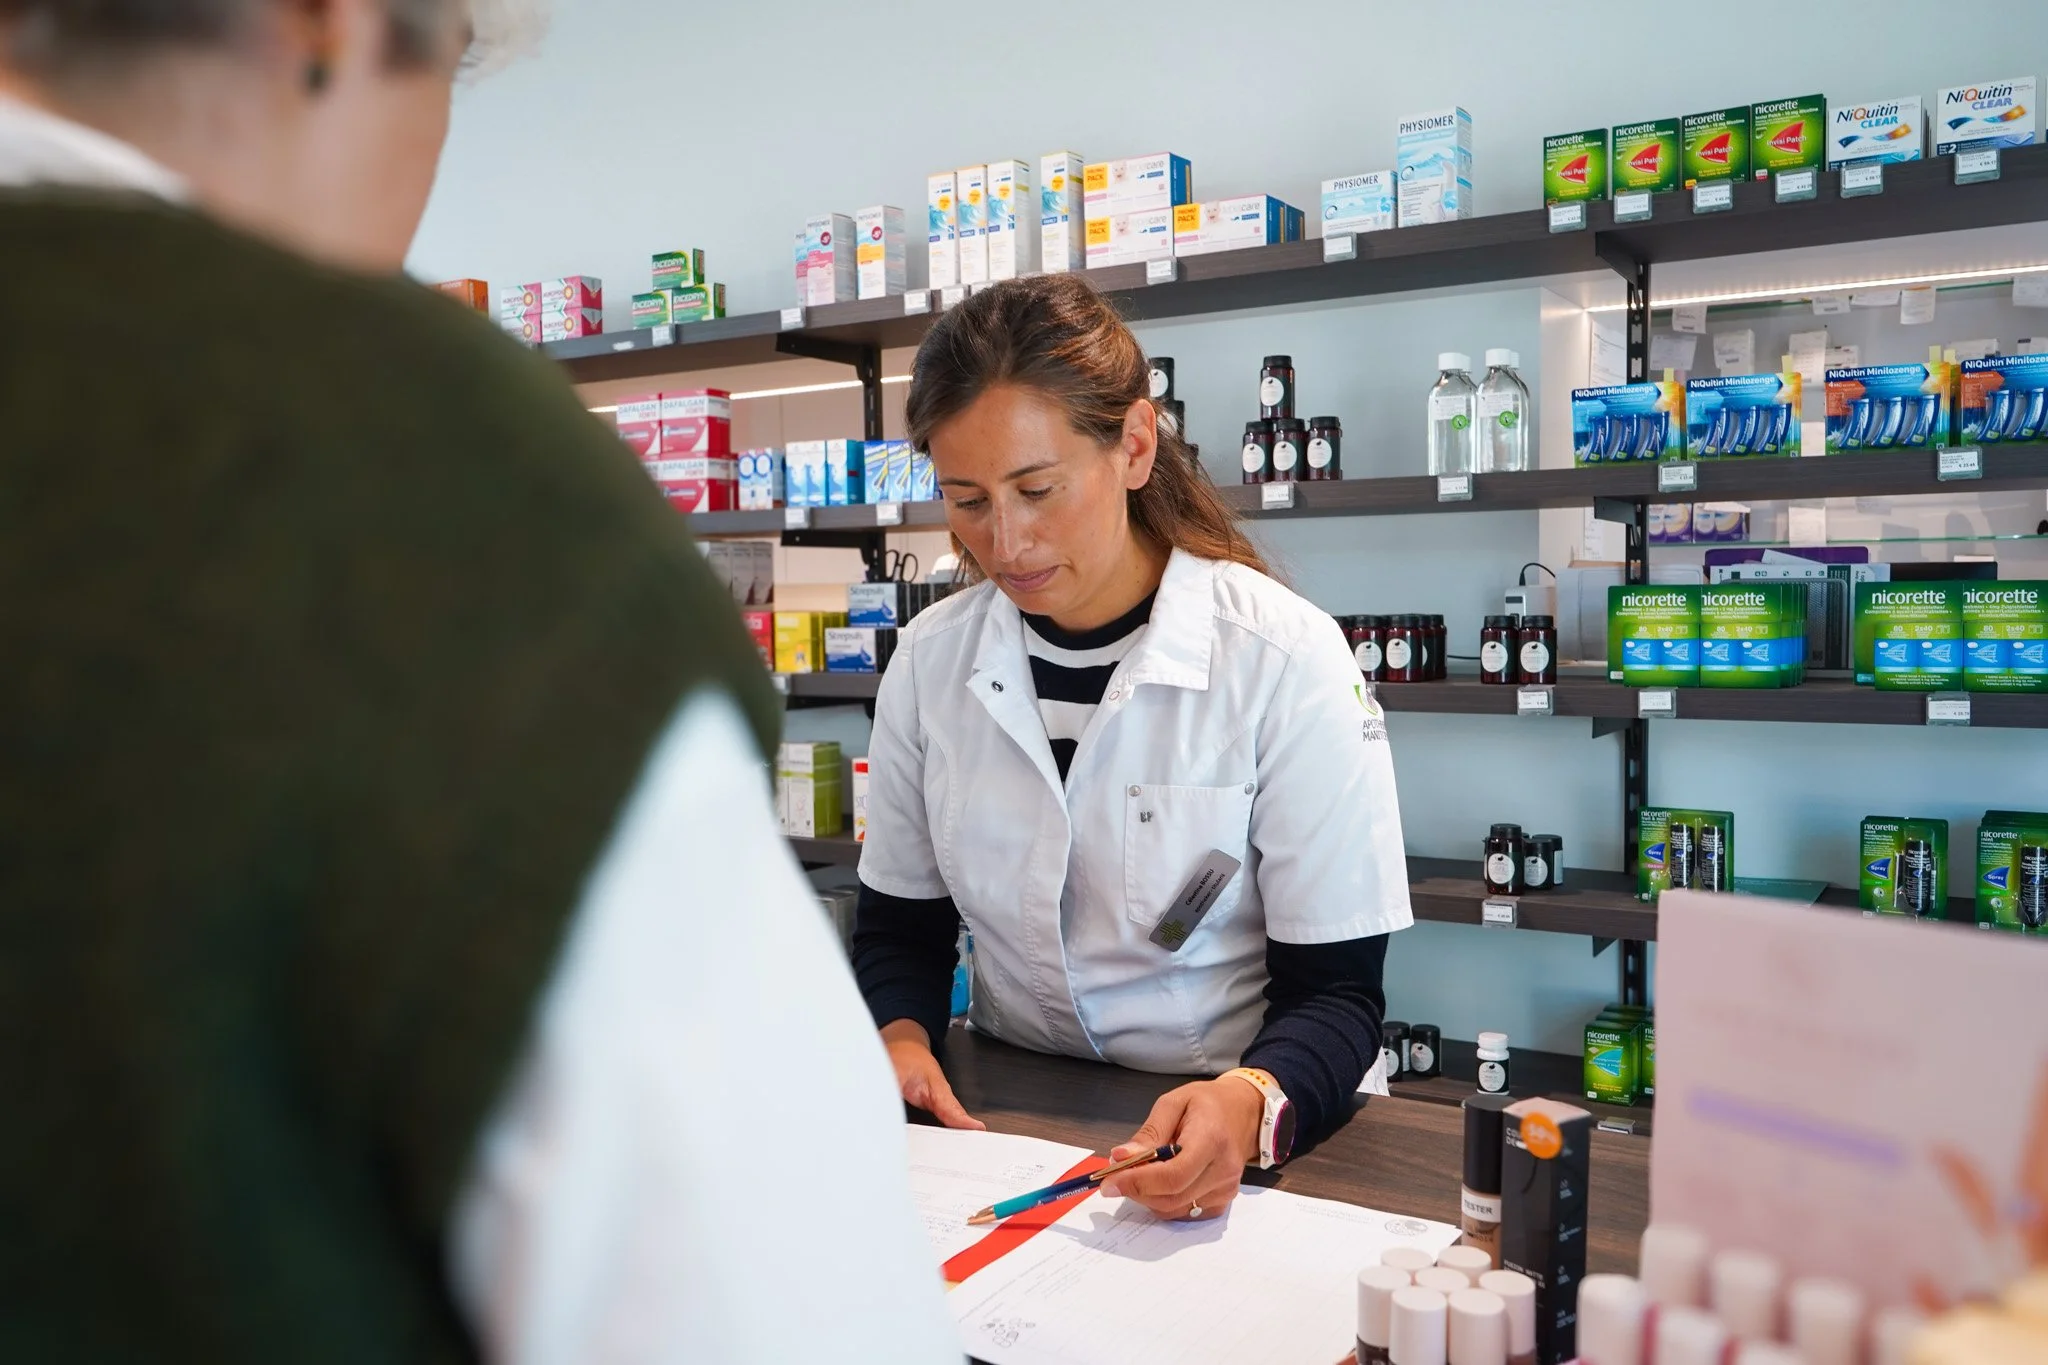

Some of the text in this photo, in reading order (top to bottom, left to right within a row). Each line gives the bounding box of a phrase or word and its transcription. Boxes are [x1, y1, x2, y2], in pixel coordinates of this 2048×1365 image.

[1946, 83, 2013, 104] NiQuitin
[1755, 99, 1798, 115] nicorette
[1972, 97, 2013, 110] CLEAR
[1684, 111, 1725, 127] nicorette
[1837, 103, 1899, 124] NiQuitin
[1400, 114, 1454, 134] PHYSIOMER
[1860, 116, 1899, 129] CLEAR
[1616, 123, 1656, 137] nicorette
[1547, 134, 1584, 149] nicorette
[1766, 135, 1807, 146] Invisi Patch
[1695, 146, 1734, 157] Invisi Patch
[1644, 156, 1663, 165] Patch
[1087, 173, 1105, 182] PACK
[1557, 167, 1592, 177] Invisi Patch
[1333, 175, 1379, 191] PHYSIOMER
[1177, 214, 1196, 223] PACK
[1089, 227, 1107, 235] PACK
[653, 257, 685, 269] EXCEDRYN
[1965, 359, 2004, 369] NiQuitin
[1829, 365, 1921, 379] NiQuitin Minilozenge
[1690, 375, 1776, 389] NiQuitin Minilozenge
[1575, 385, 1655, 398] NiQuitin Minilozenge
[619, 403, 656, 414] DAFALGAN
[664, 398, 705, 409] DAFALGAN
[663, 461, 704, 471] DAFALGAN
[1622, 592, 1687, 607] nicorette
[1871, 589, 1946, 605] nicorette
[1641, 810, 1671, 818] nicorette
[1864, 823, 1899, 831] nicorette
[1980, 830, 2018, 839] nicorette
[1199, 868, 1215, 886] BOSSU
[1587, 1031, 1620, 1041] nicorette
[1464, 1198, 1493, 1215] TESTER
